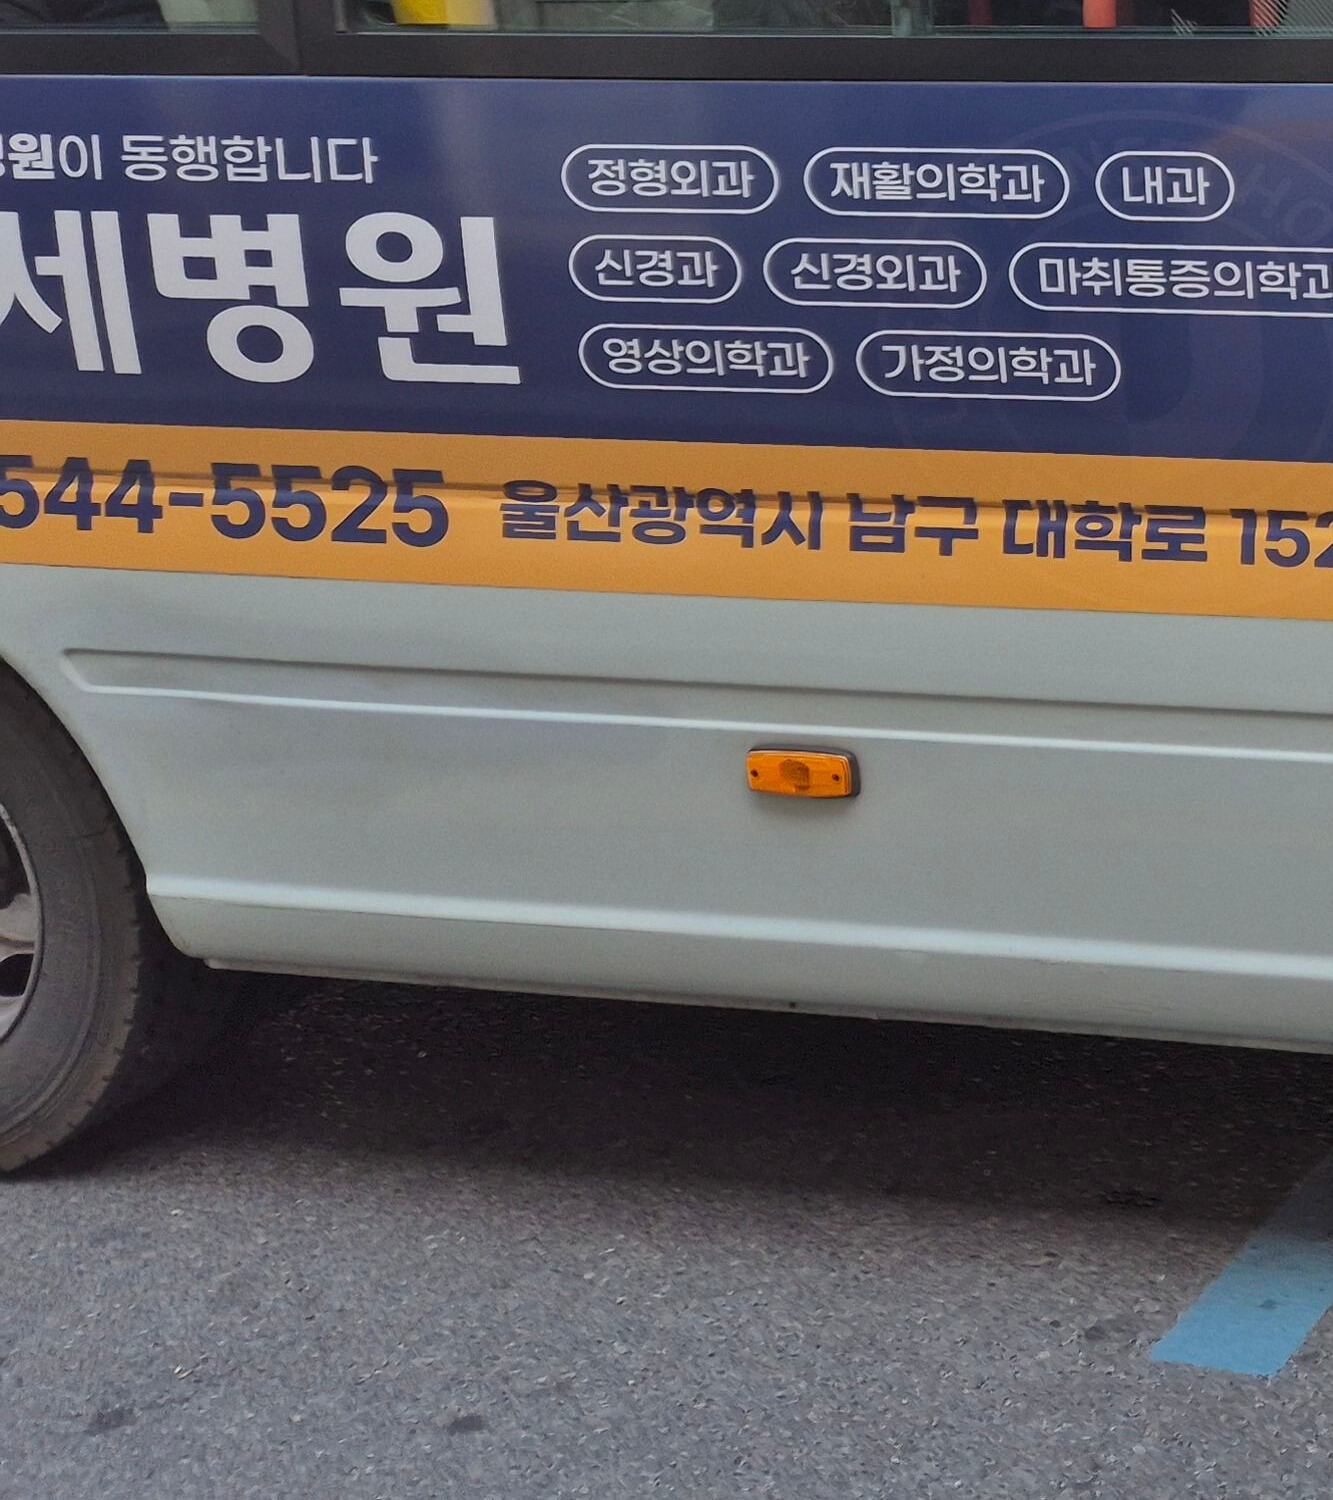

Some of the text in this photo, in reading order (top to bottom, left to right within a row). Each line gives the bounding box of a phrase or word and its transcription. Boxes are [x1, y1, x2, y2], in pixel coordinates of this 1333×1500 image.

[120, 135, 380, 184] 동행합니다
[587, 158, 755, 198] 정형외과
[829, 160, 1046, 204] 재활의학과
[1122, 166, 1210, 206] 내과
[594, 248, 721, 290] 신경과
[790, 252, 961, 294] 신경외과
[0, 210, 521, 385] 세병원
[603, 336, 811, 380] 영상의학과
[882, 344, 1097, 388] 가정의학과
[500, 478, 822, 550] 울산광역시
[847, 491, 980, 557] 남구
[1002, 498, 1208, 563] 대학로
